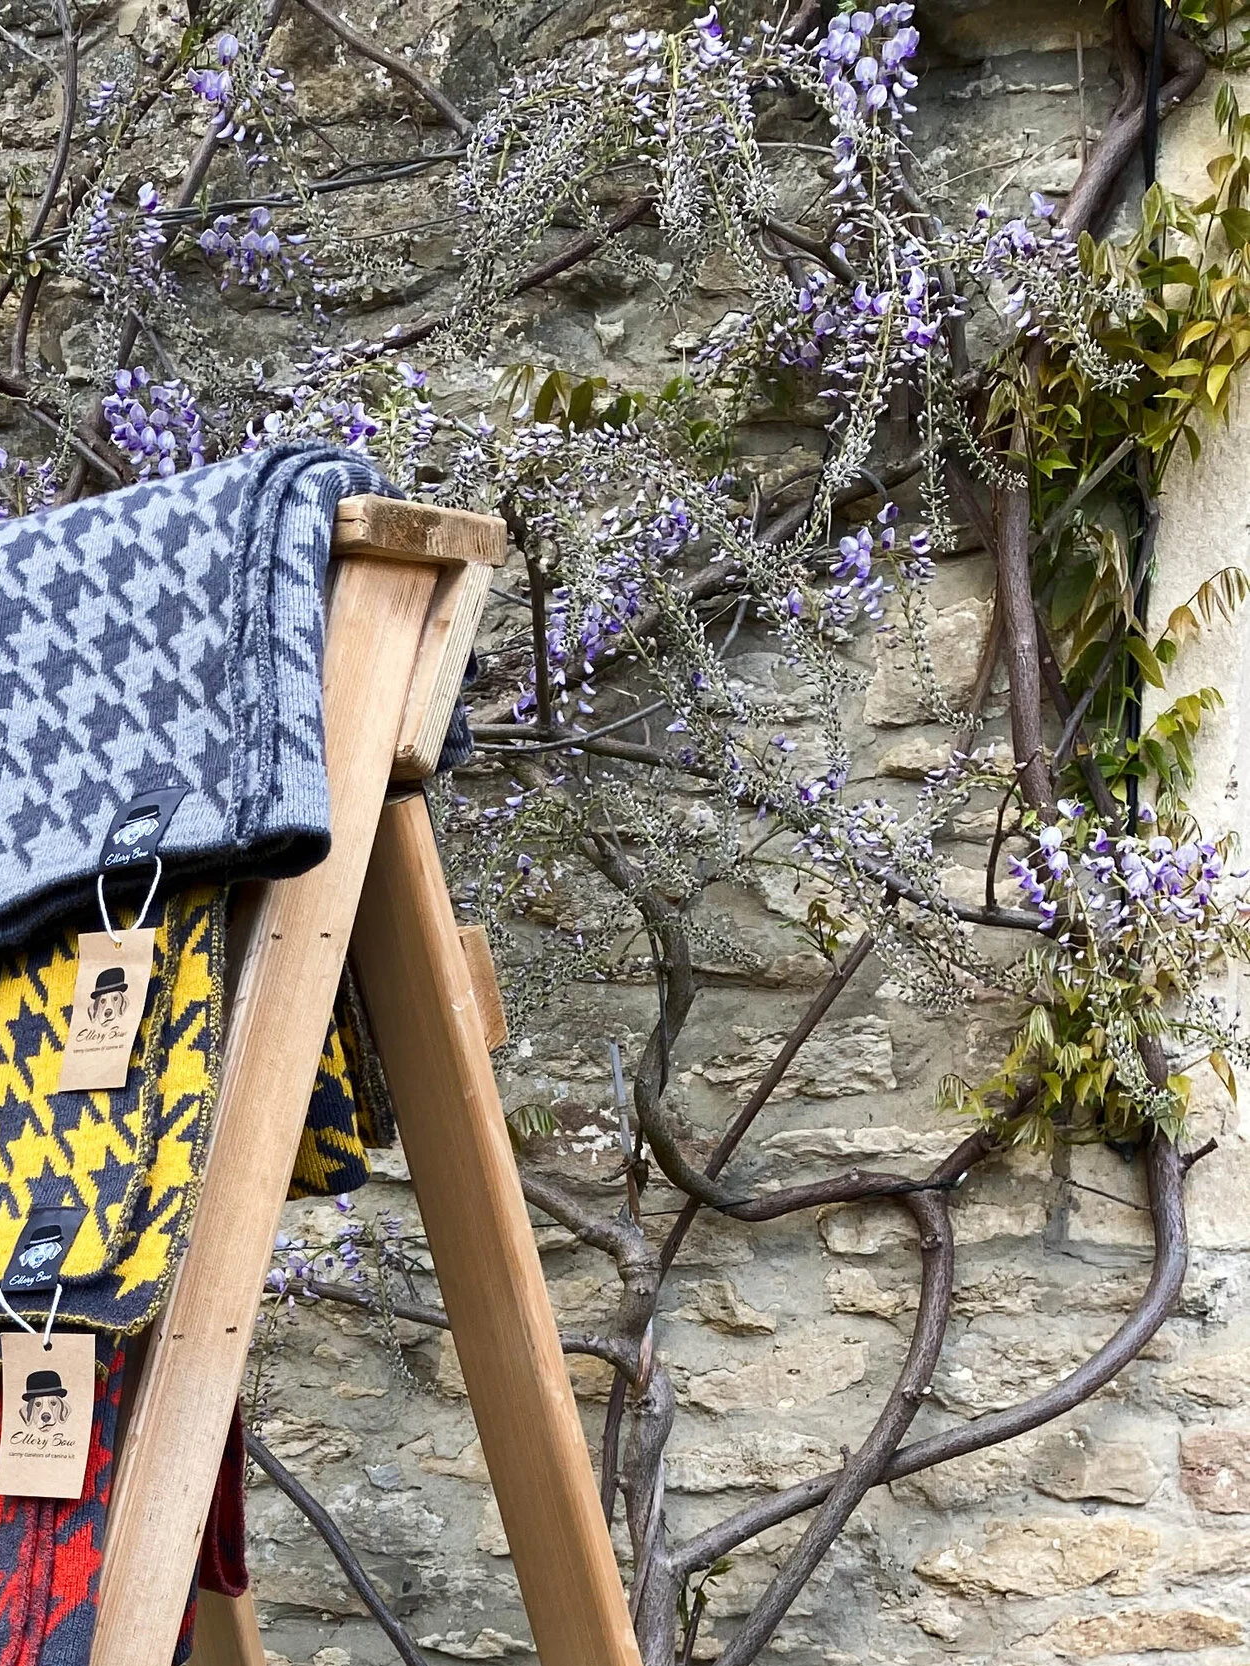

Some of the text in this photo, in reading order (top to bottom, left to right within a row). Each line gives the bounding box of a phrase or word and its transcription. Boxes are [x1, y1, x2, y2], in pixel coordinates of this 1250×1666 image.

[76, 1028, 107, 1044] Ellery
[10, 1431, 76, 1450] Ellery Bow
